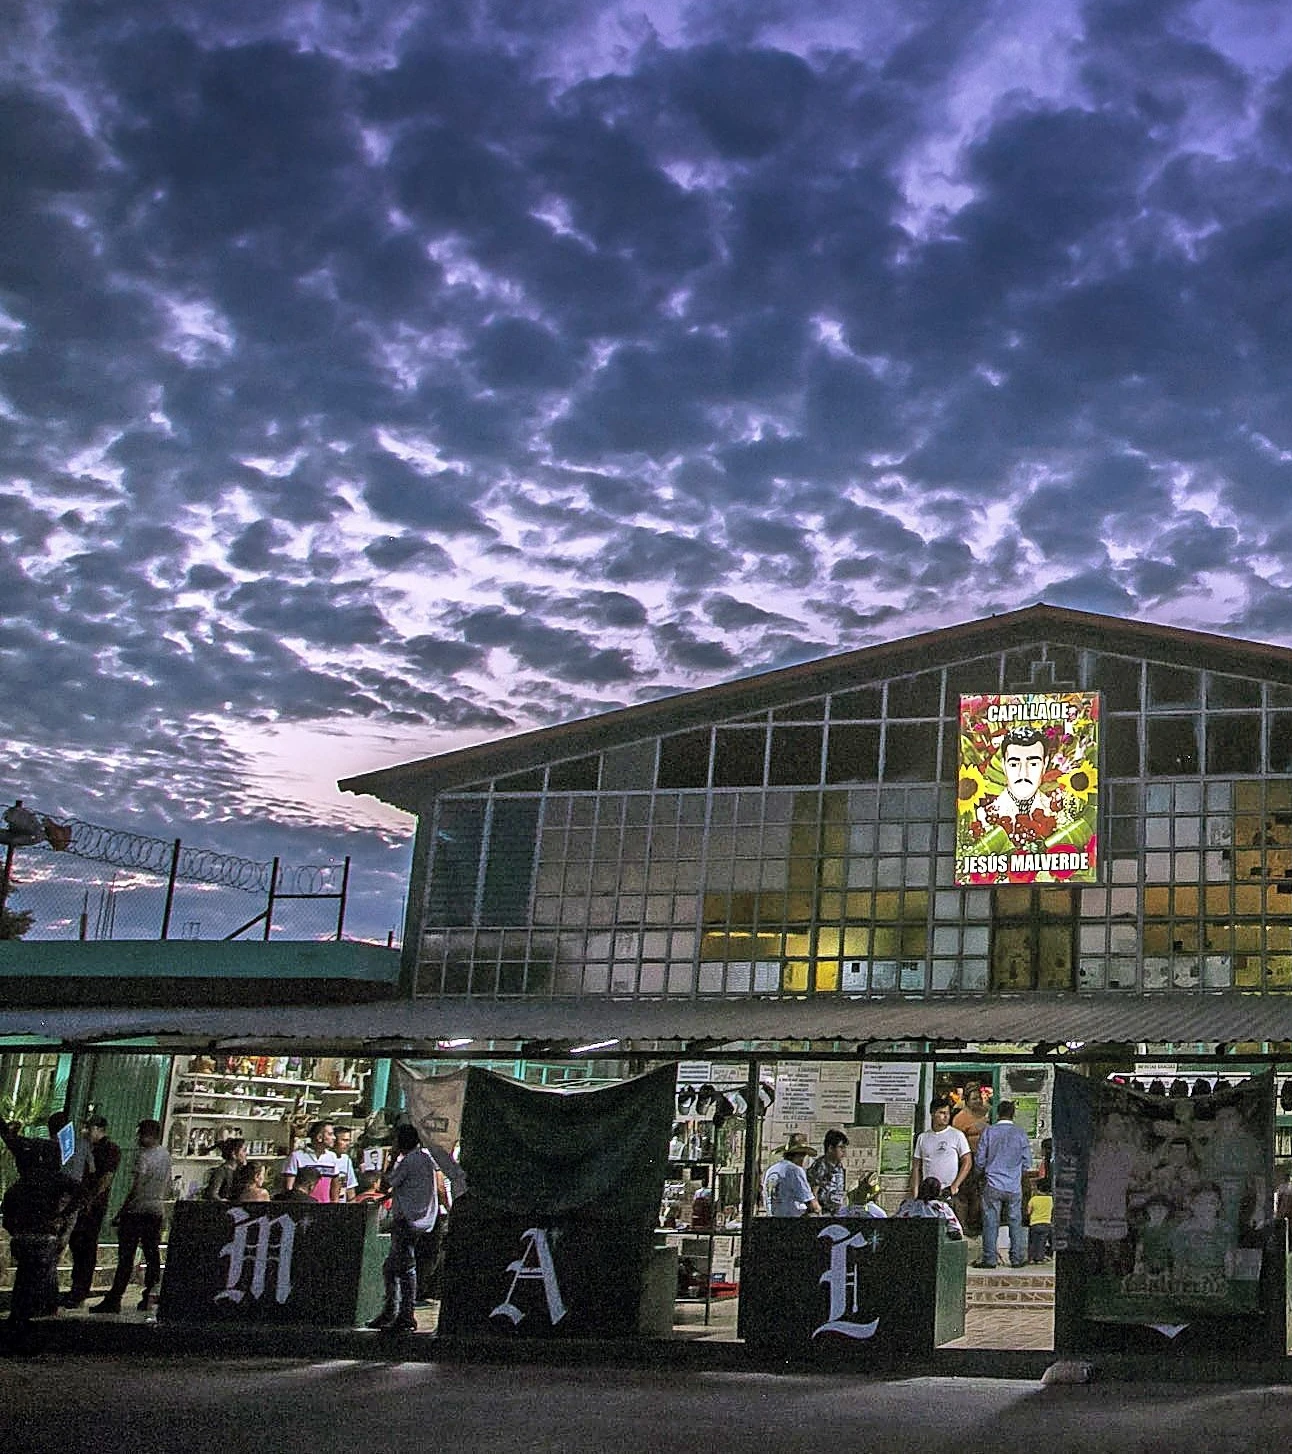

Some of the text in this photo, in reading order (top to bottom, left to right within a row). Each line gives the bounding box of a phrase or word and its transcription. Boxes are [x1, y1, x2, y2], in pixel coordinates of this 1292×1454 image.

[988, 702, 1070, 722] CAPILLA DE
[963, 852, 1089, 873] JESÚS MALVERDE
[489, 1228, 568, 1325] A
